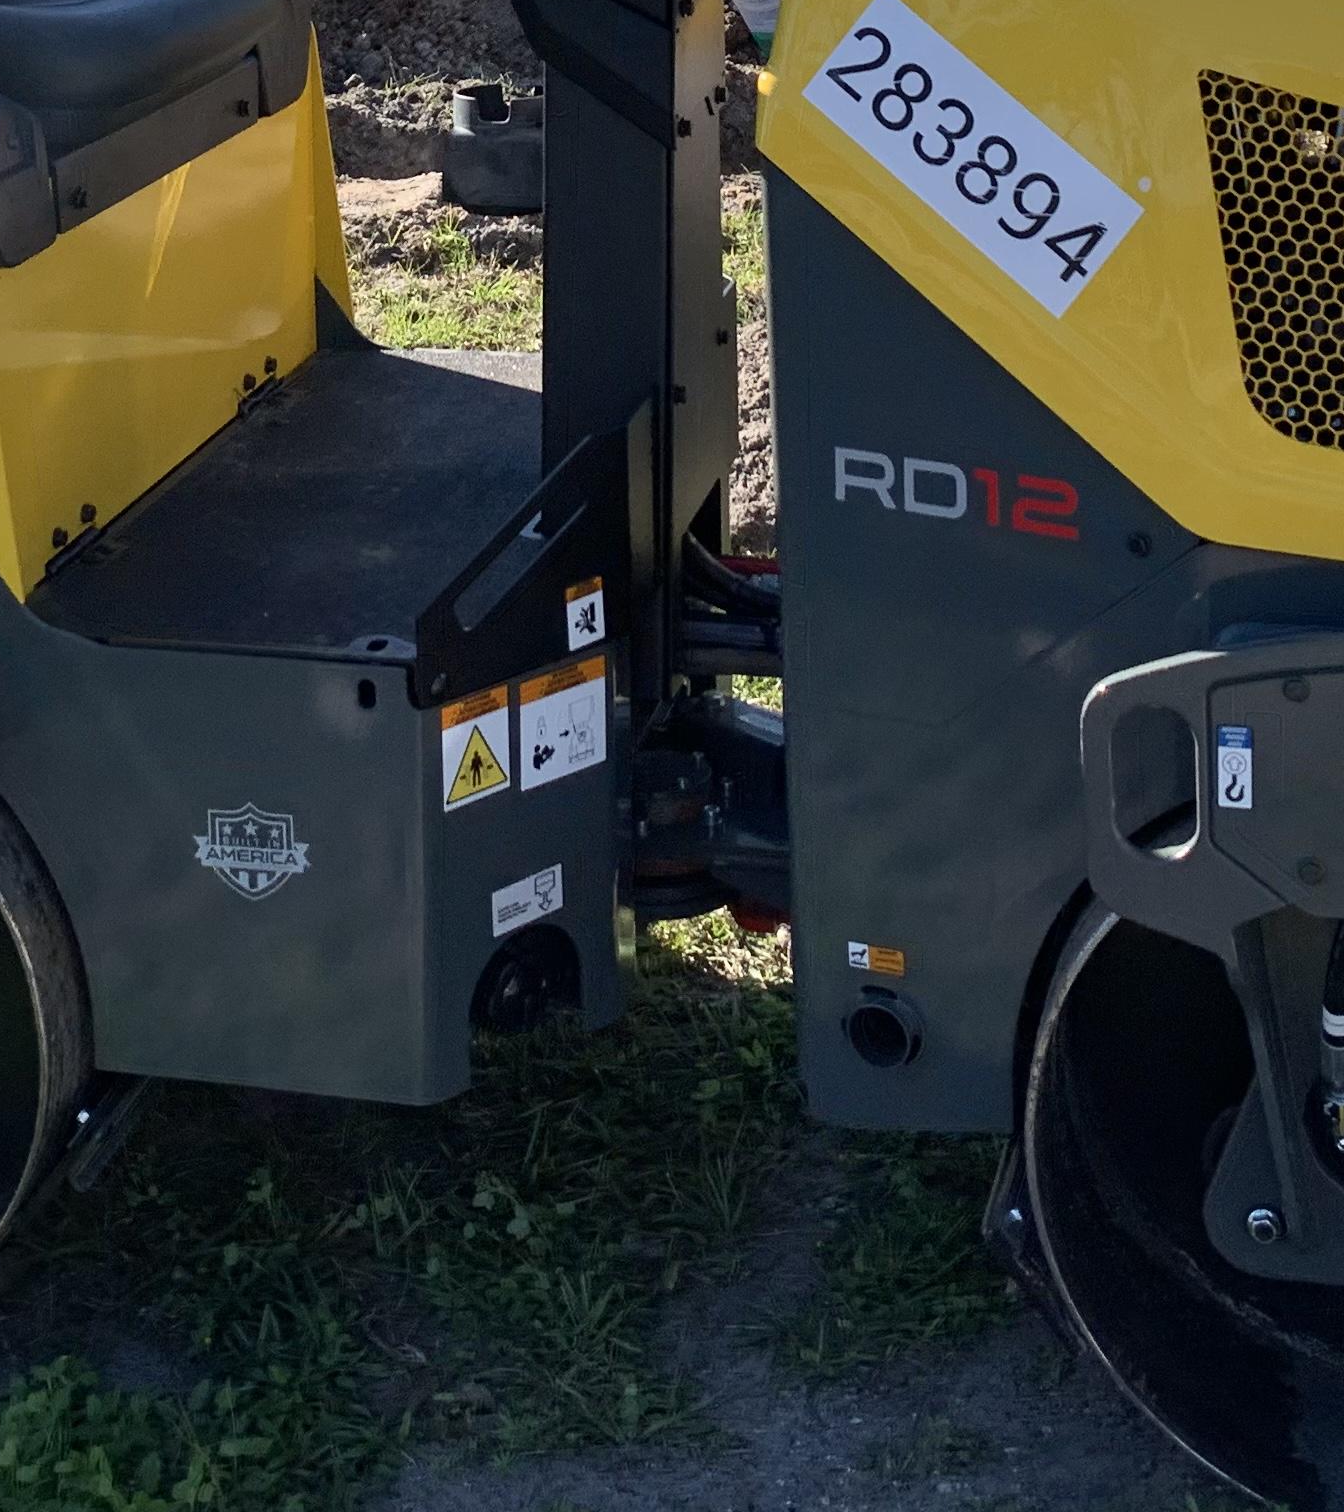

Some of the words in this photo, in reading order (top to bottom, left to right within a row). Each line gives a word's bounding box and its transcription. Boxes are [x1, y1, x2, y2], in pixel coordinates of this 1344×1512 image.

[825, 26, 1108, 284] 283894
[834, 446, 1080, 542] RD12
[205, 846, 299, 866] AMERICA
[221, 835, 260, 848] BUILT
